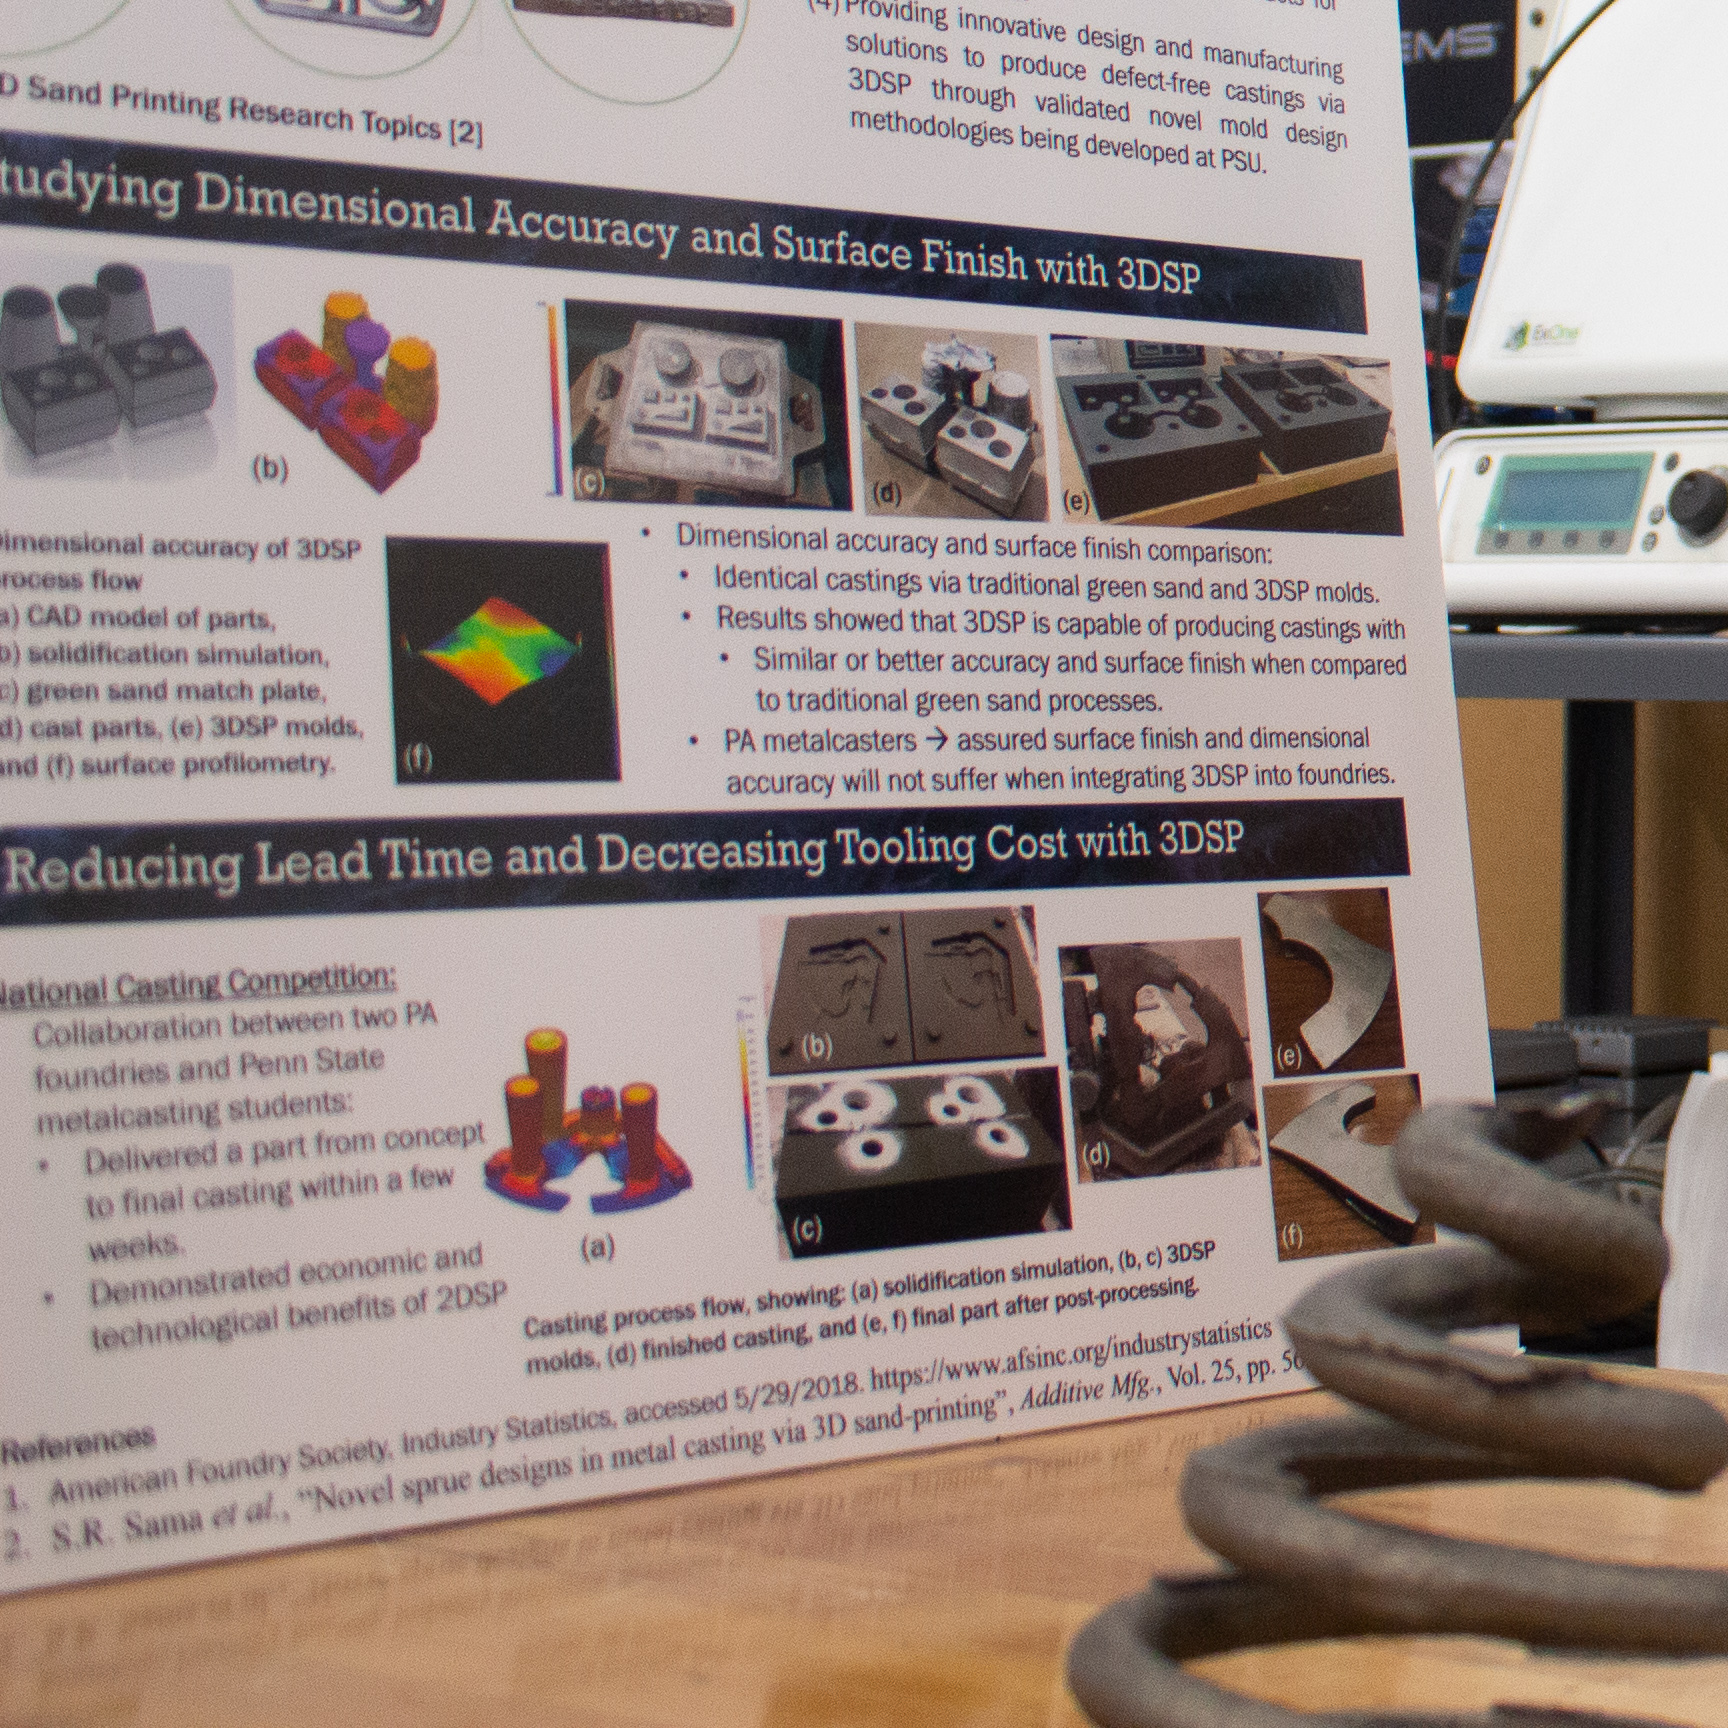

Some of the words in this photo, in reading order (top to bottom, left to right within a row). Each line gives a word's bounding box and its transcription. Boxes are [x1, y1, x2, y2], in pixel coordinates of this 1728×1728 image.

[30, 77, 102, 107] Sand
[114, 86, 221, 124] Printing
[231, 98, 354, 131] Research
[364, 111, 442, 141] Topics
[451, 120, 483, 150] [2]
[198, 172, 476, 234] Dimensional
[488, 199, 680, 261] Accuracy
[693, 223, 764, 259] and
[774, 225, 912, 272] Surface
[923, 239, 1029, 281] Finish
[1037, 253, 1109, 288] with
[1119, 258, 1201, 296] 3DSP
[252, 455, 289, 484] (b)
[574, 468, 606, 497] (c)
[872, 480, 902, 508] (d)
[1062, 488, 1091, 517] (e)
[679, 523, 828, 552] Dimensional
[837, 534, 939, 559] accuracy
[947, 534, 988, 557] and
[996, 535, 1077, 560] surface
[1084, 537, 1142, 561] finish
[1149, 544, 1273, 568] comparison:
[717, 566, 818, 591] Identical
[827, 572, 923, 598] castings
[930, 576, 961, 594] via
[969, 574, 1080, 598] traditional
[1089, 579, 1147, 603] green
[1154, 579, 1204, 600] sand
[1212, 580, 1249, 602] and
[1256, 579, 1310, 603] 3DSP
[1317, 583, 1380, 604] molds.
[8, 845, 242, 892] Reducing
[259, 840, 371, 884] Lead
[382, 840, 493, 880] Time
[508, 836, 587, 877] and
[599, 831, 827, 876] Decreasing
[836, 828, 976, 872] Tooling
[988, 825, 1068, 862] Cost
[1077, 822, 1151, 859] with
[1161, 820, 1245, 856] 3DSP
[802, 1033, 834, 1060] (b)
[1277, 1045, 1302, 1070] (e)
[1082, 1143, 1110, 1169] (d)
[792, 1215, 823, 1243] (c)
[1282, 1225, 1303, 1249] (f)
[581, 1234, 615, 1262] (a)
[525, 1315, 607, 1340] Casting
[616, 1306, 696, 1333] process
[703, 1299, 750, 1317] flow,
[853, 1284, 879, 1303] (a)
[885, 1269, 1006, 1298] solidification
[1012, 1257, 1114, 1283] simulation,
[1169, 1241, 1216, 1265] 3DSP
[626, 1392, 728, 1427] accessed
